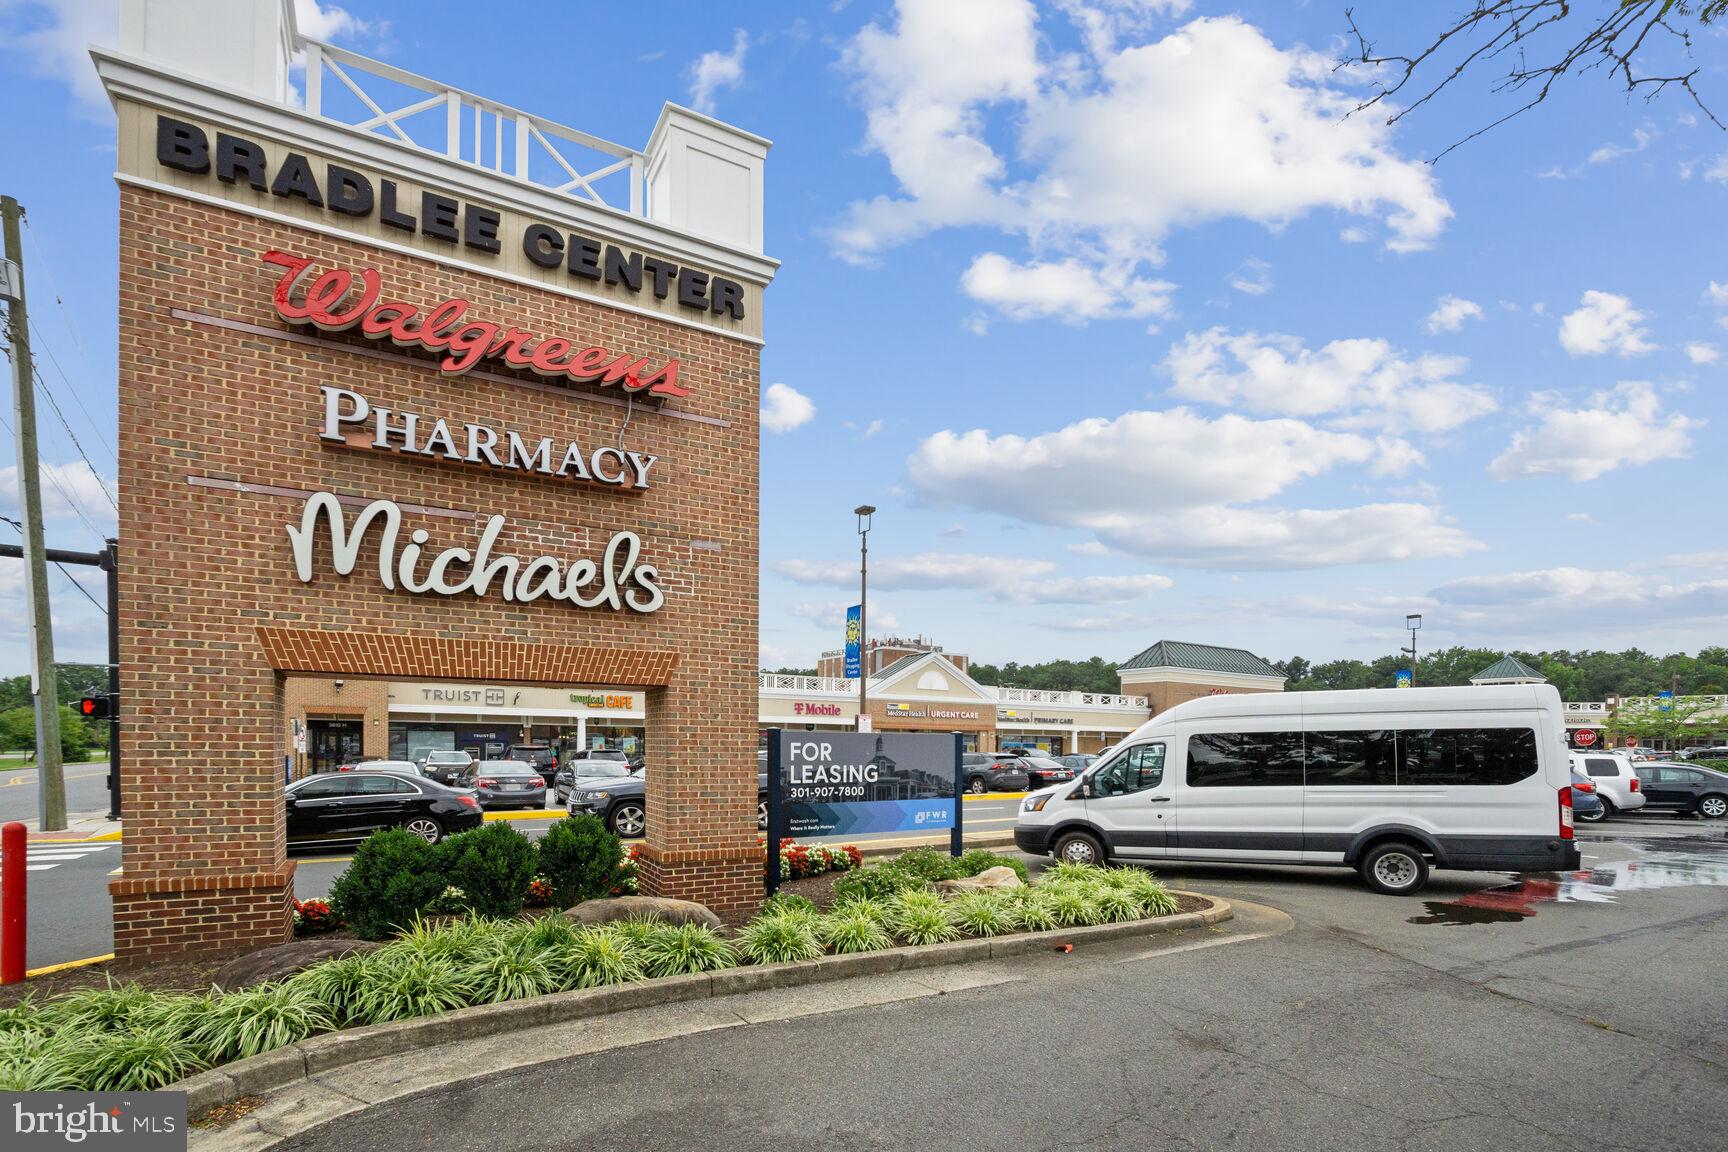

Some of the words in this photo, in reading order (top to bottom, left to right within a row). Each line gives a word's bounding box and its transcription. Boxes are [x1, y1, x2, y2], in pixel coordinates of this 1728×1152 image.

[157, 114, 501, 255] BRADLEE
[523, 223, 746, 321] CENTER
[262, 251, 690, 397] Walgreens
[319, 385, 658, 491] PHARMACY
[285, 491, 666, 614] Michaels
[422, 688, 481, 701] TRUIST
[606, 694, 633, 709] CAFE
[931, 709, 959, 719] URGENT
[960, 711, 979, 719] CARE
[1576, 733, 1595, 741] STOP
[790, 742, 832, 761] FOR
[790, 764, 878, 784] LEASING
[790, 786, 865, 798] 301-907-7800
[926, 810, 948, 820] FWR
